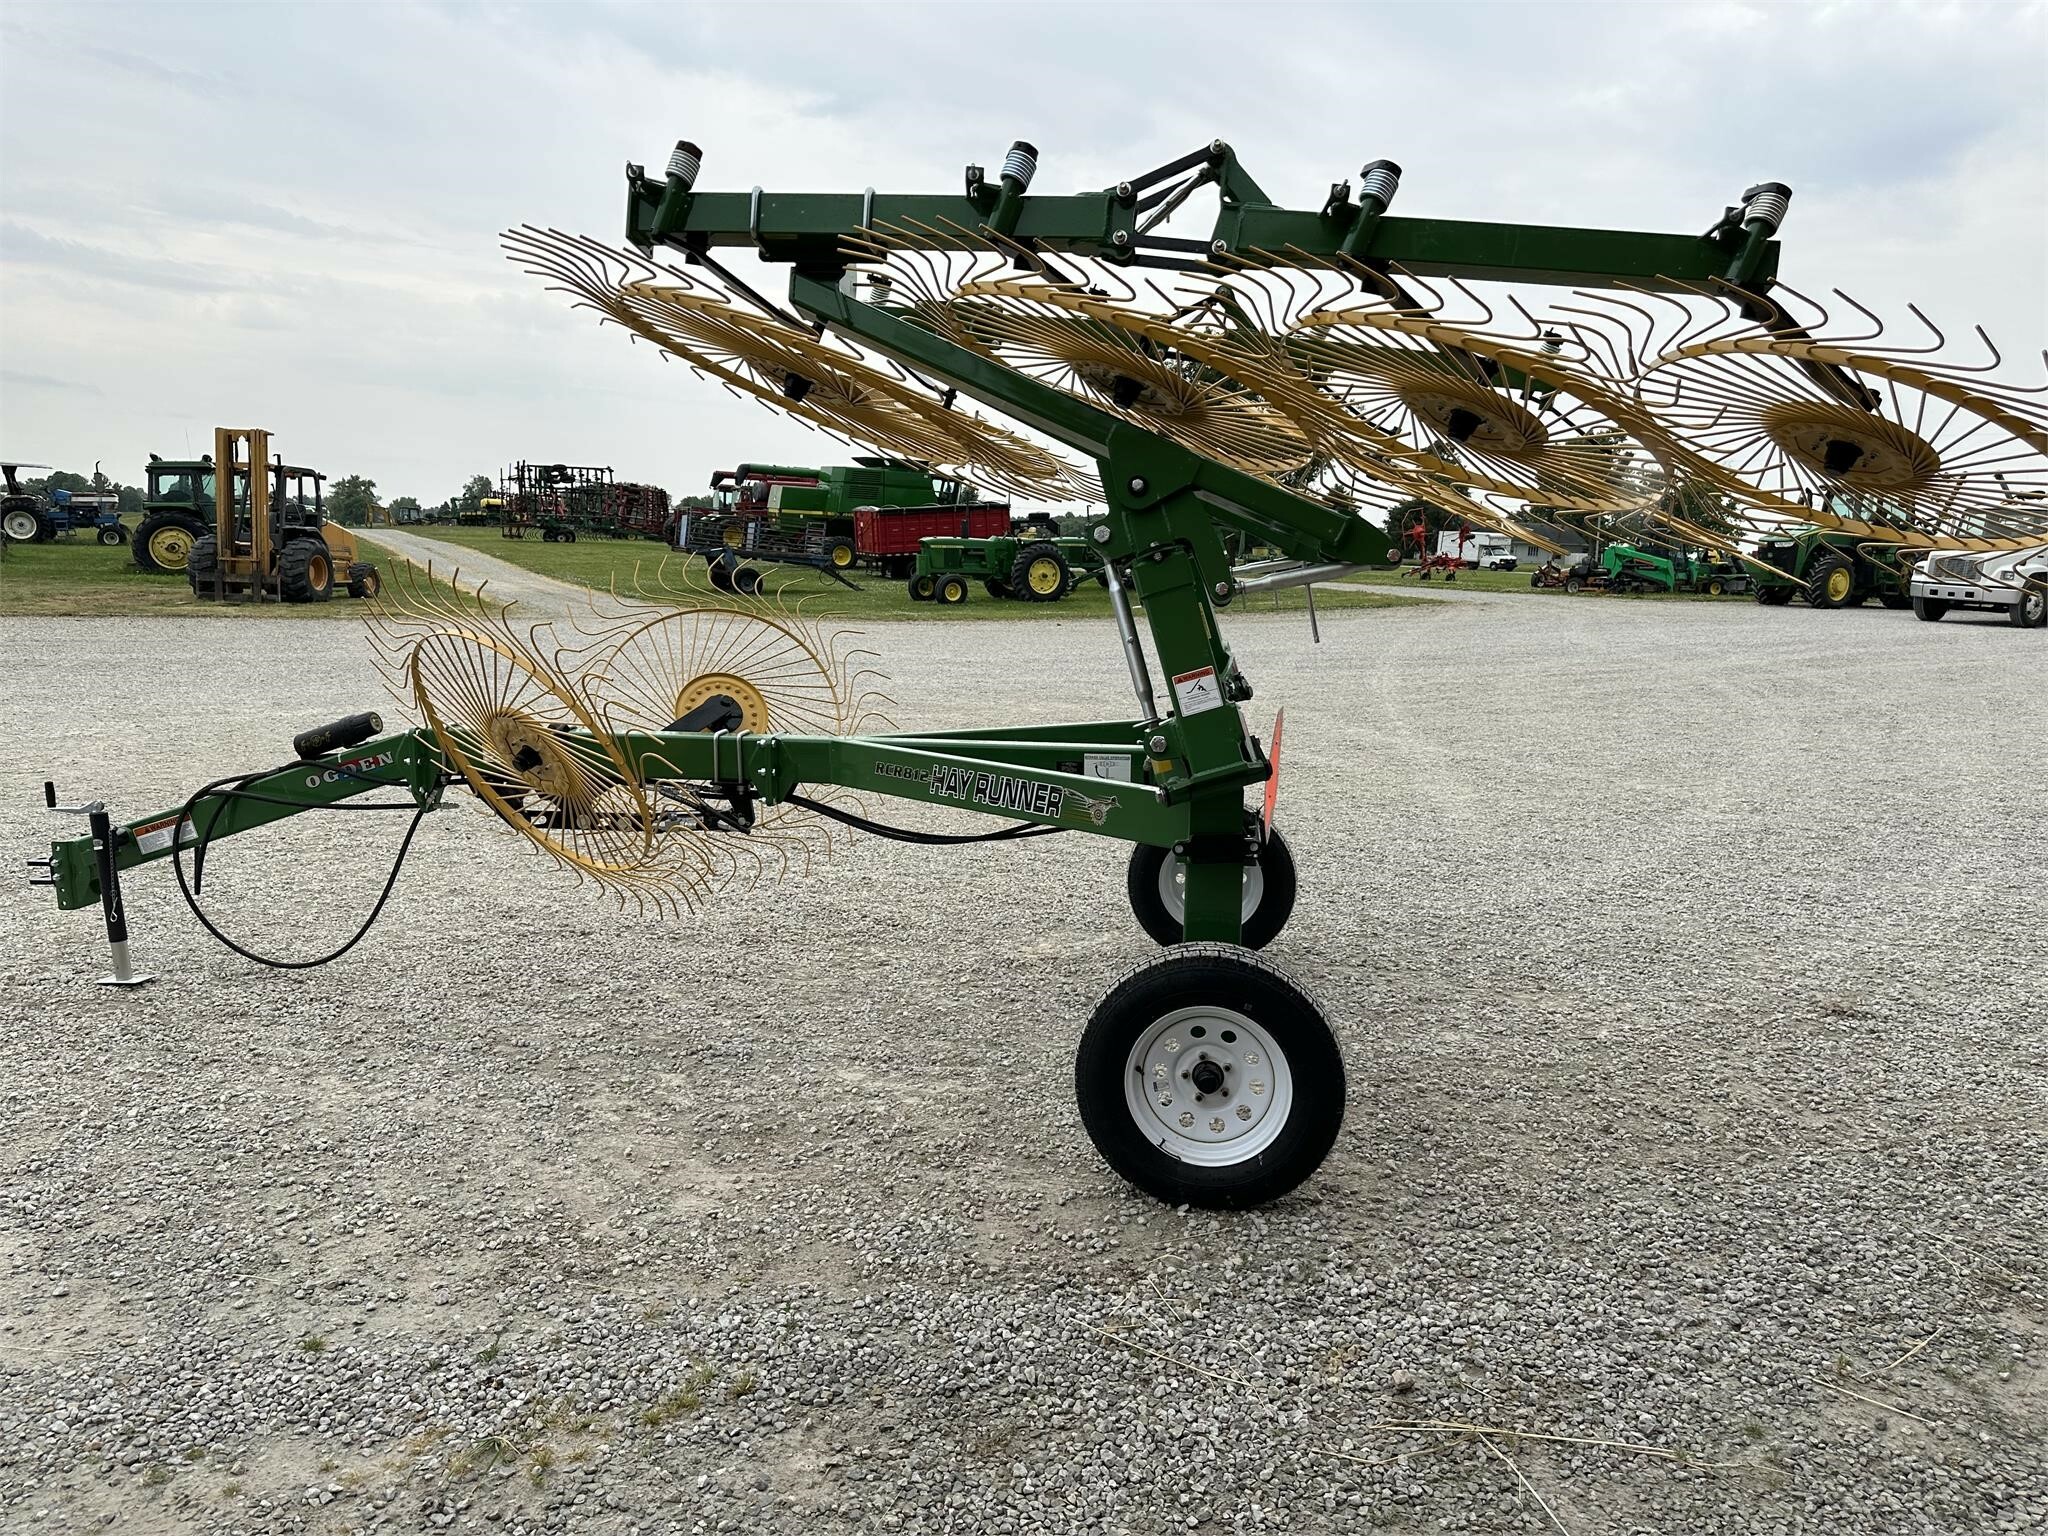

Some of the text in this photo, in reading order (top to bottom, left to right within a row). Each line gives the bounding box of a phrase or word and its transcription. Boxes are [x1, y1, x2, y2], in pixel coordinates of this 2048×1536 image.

[305, 751, 394, 788] OGDEN
[929, 764, 974, 800] HAY
[973, 772, 1064, 818] RUNNER
